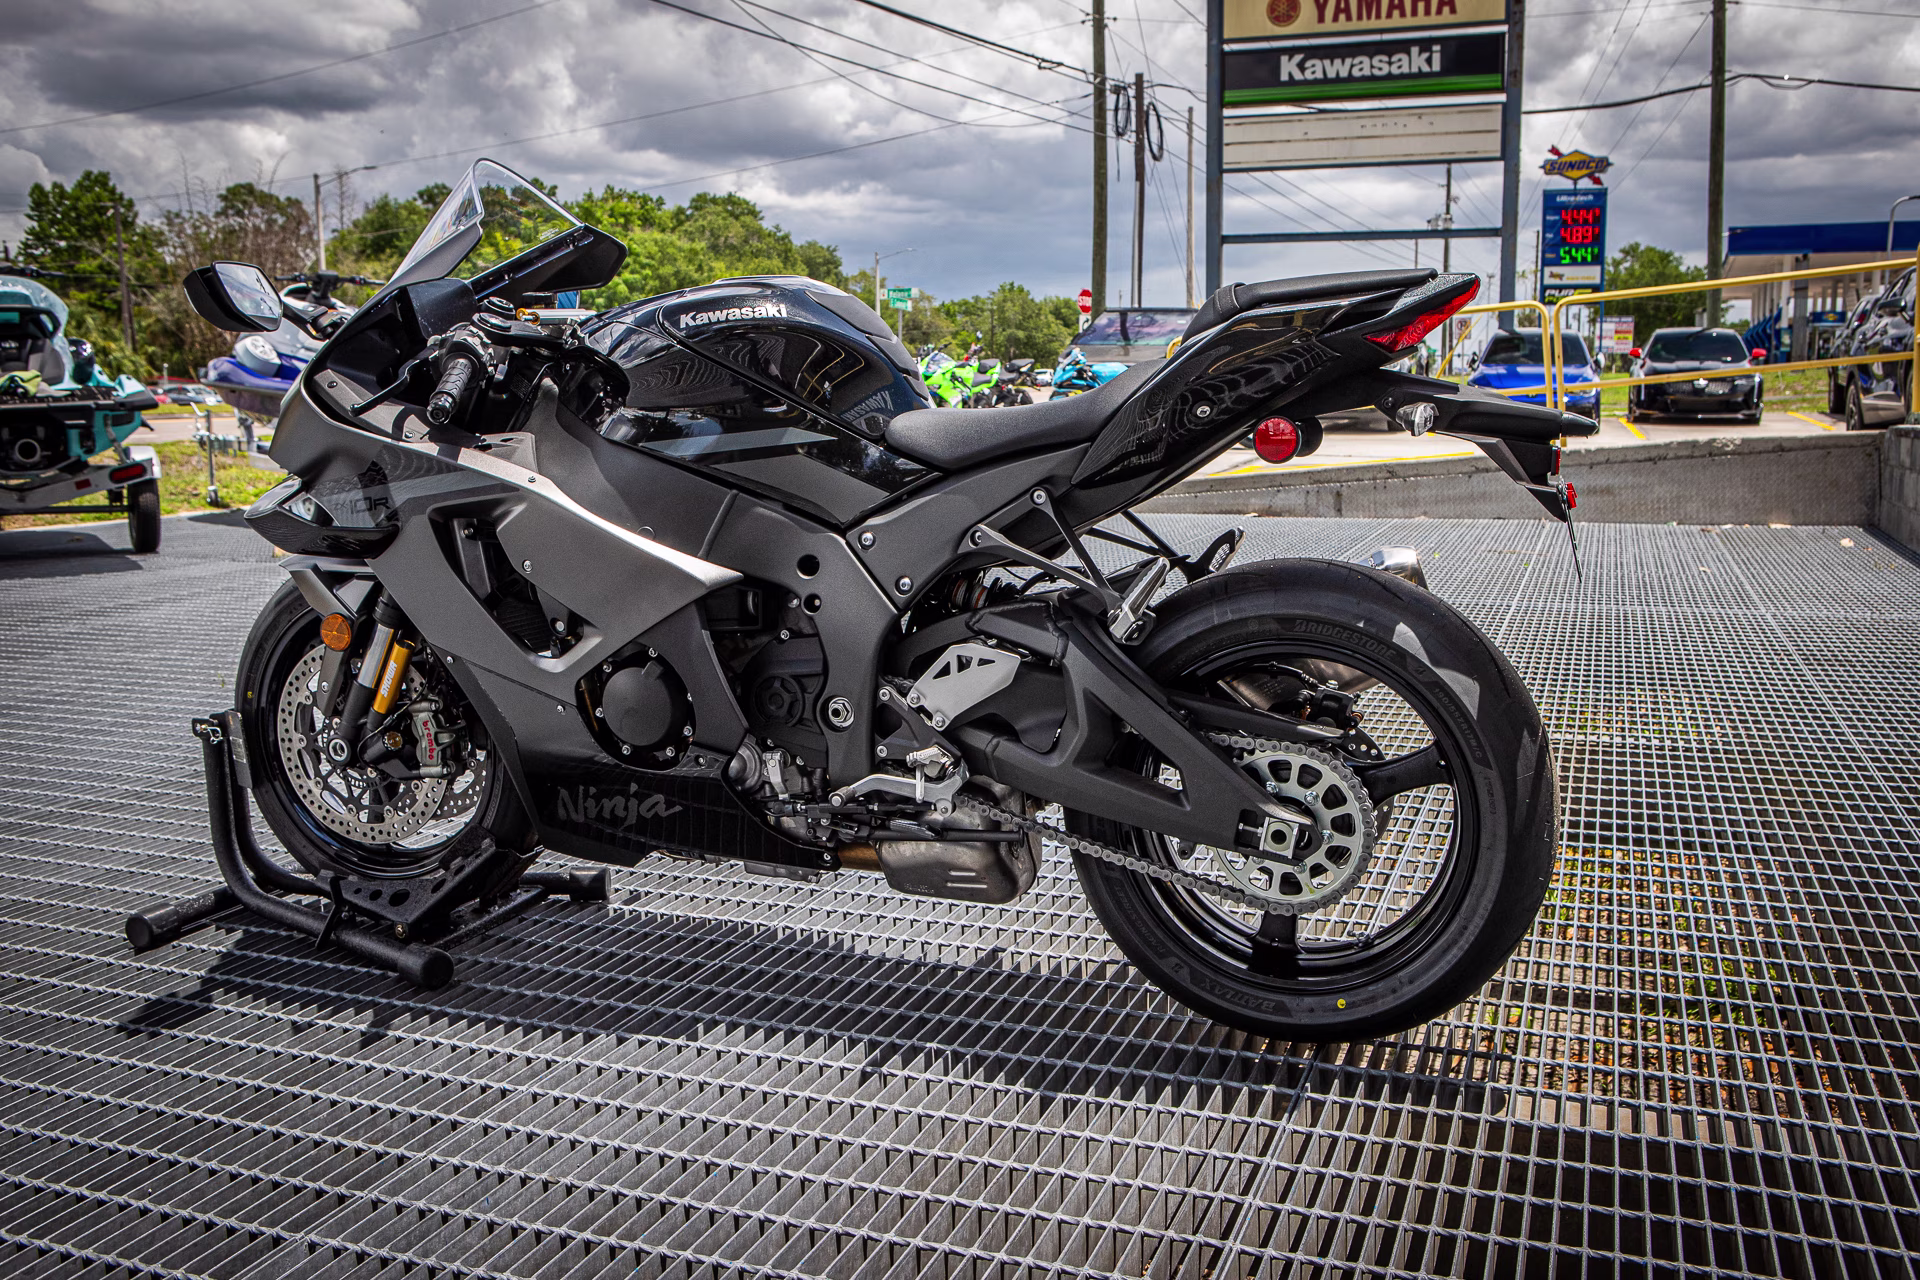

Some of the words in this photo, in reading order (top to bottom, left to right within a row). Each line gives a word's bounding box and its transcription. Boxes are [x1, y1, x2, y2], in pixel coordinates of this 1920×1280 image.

[1279, 44, 1442, 82] Kawasaki
[1547, 159, 1606, 173] SUNOCO
[680, 303, 788, 329] Kawasaki
[1293, 619, 1398, 661] BRIDGESTONE
[380, 659, 398, 698] SHOWA
[422, 720, 437, 761] brembo
[557, 782, 683, 832] Ninja
[1200, 977, 1277, 1013] BATTLAX
